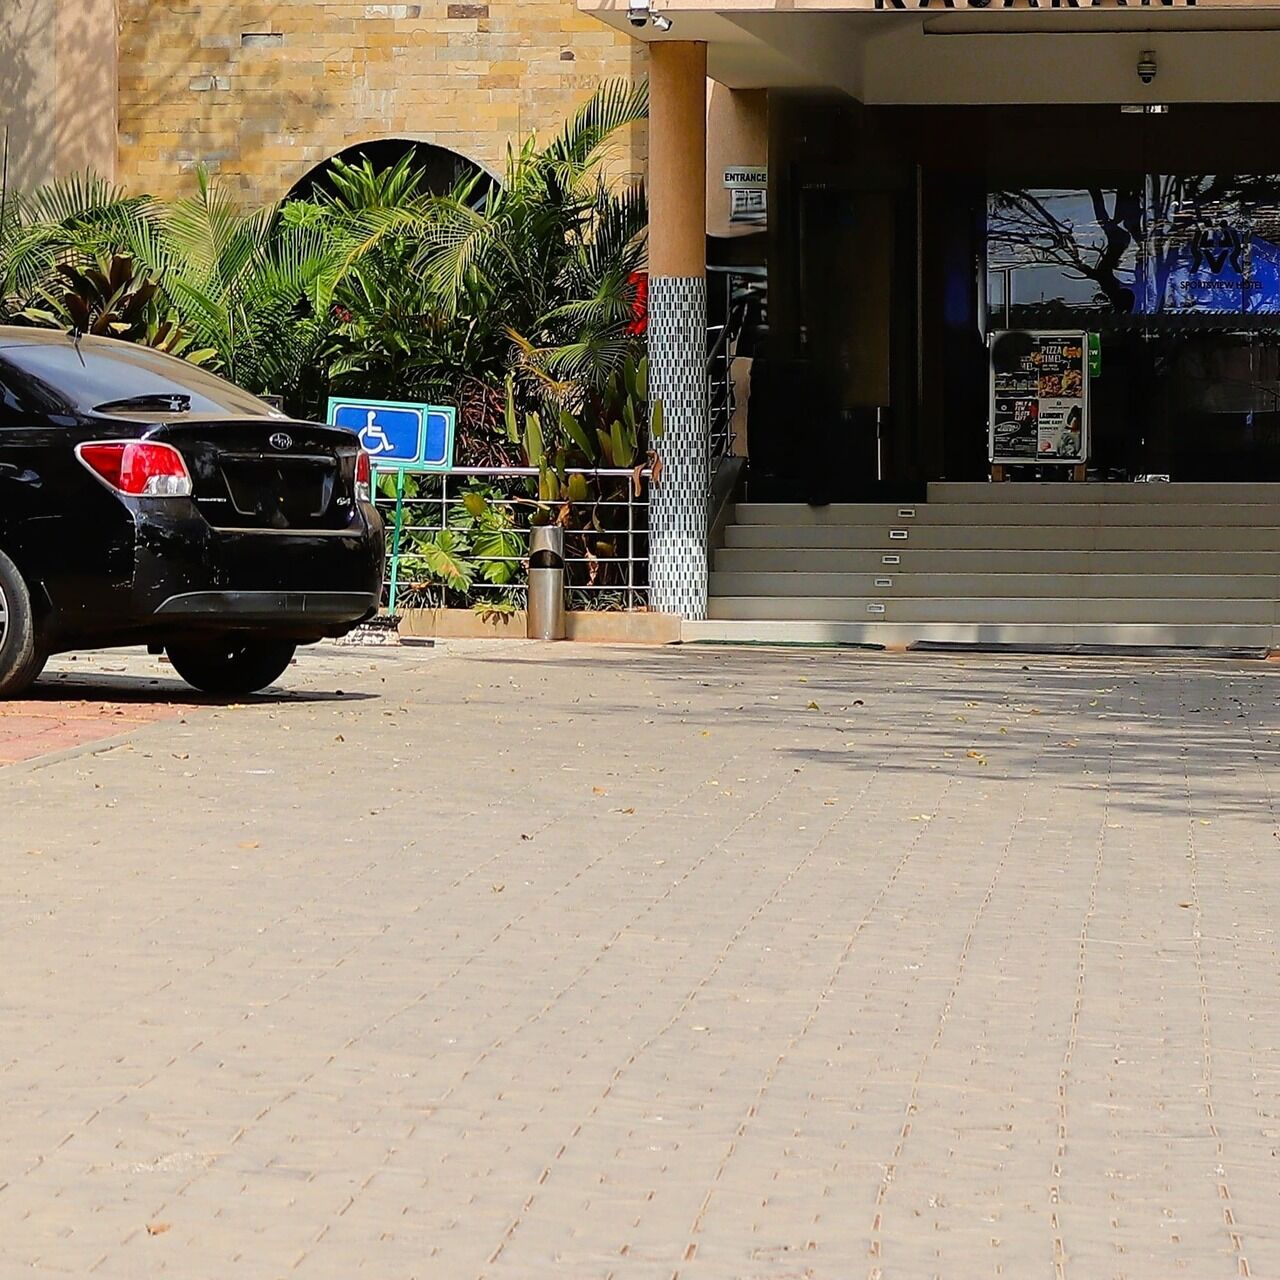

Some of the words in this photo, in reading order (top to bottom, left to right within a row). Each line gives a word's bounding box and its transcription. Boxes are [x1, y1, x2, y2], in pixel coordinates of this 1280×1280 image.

[724, 172, 767, 182] ENTRANCE
[1180, 281, 1233, 290] SPORTSVIEW
[1041, 346, 1062, 354] PIZZA
